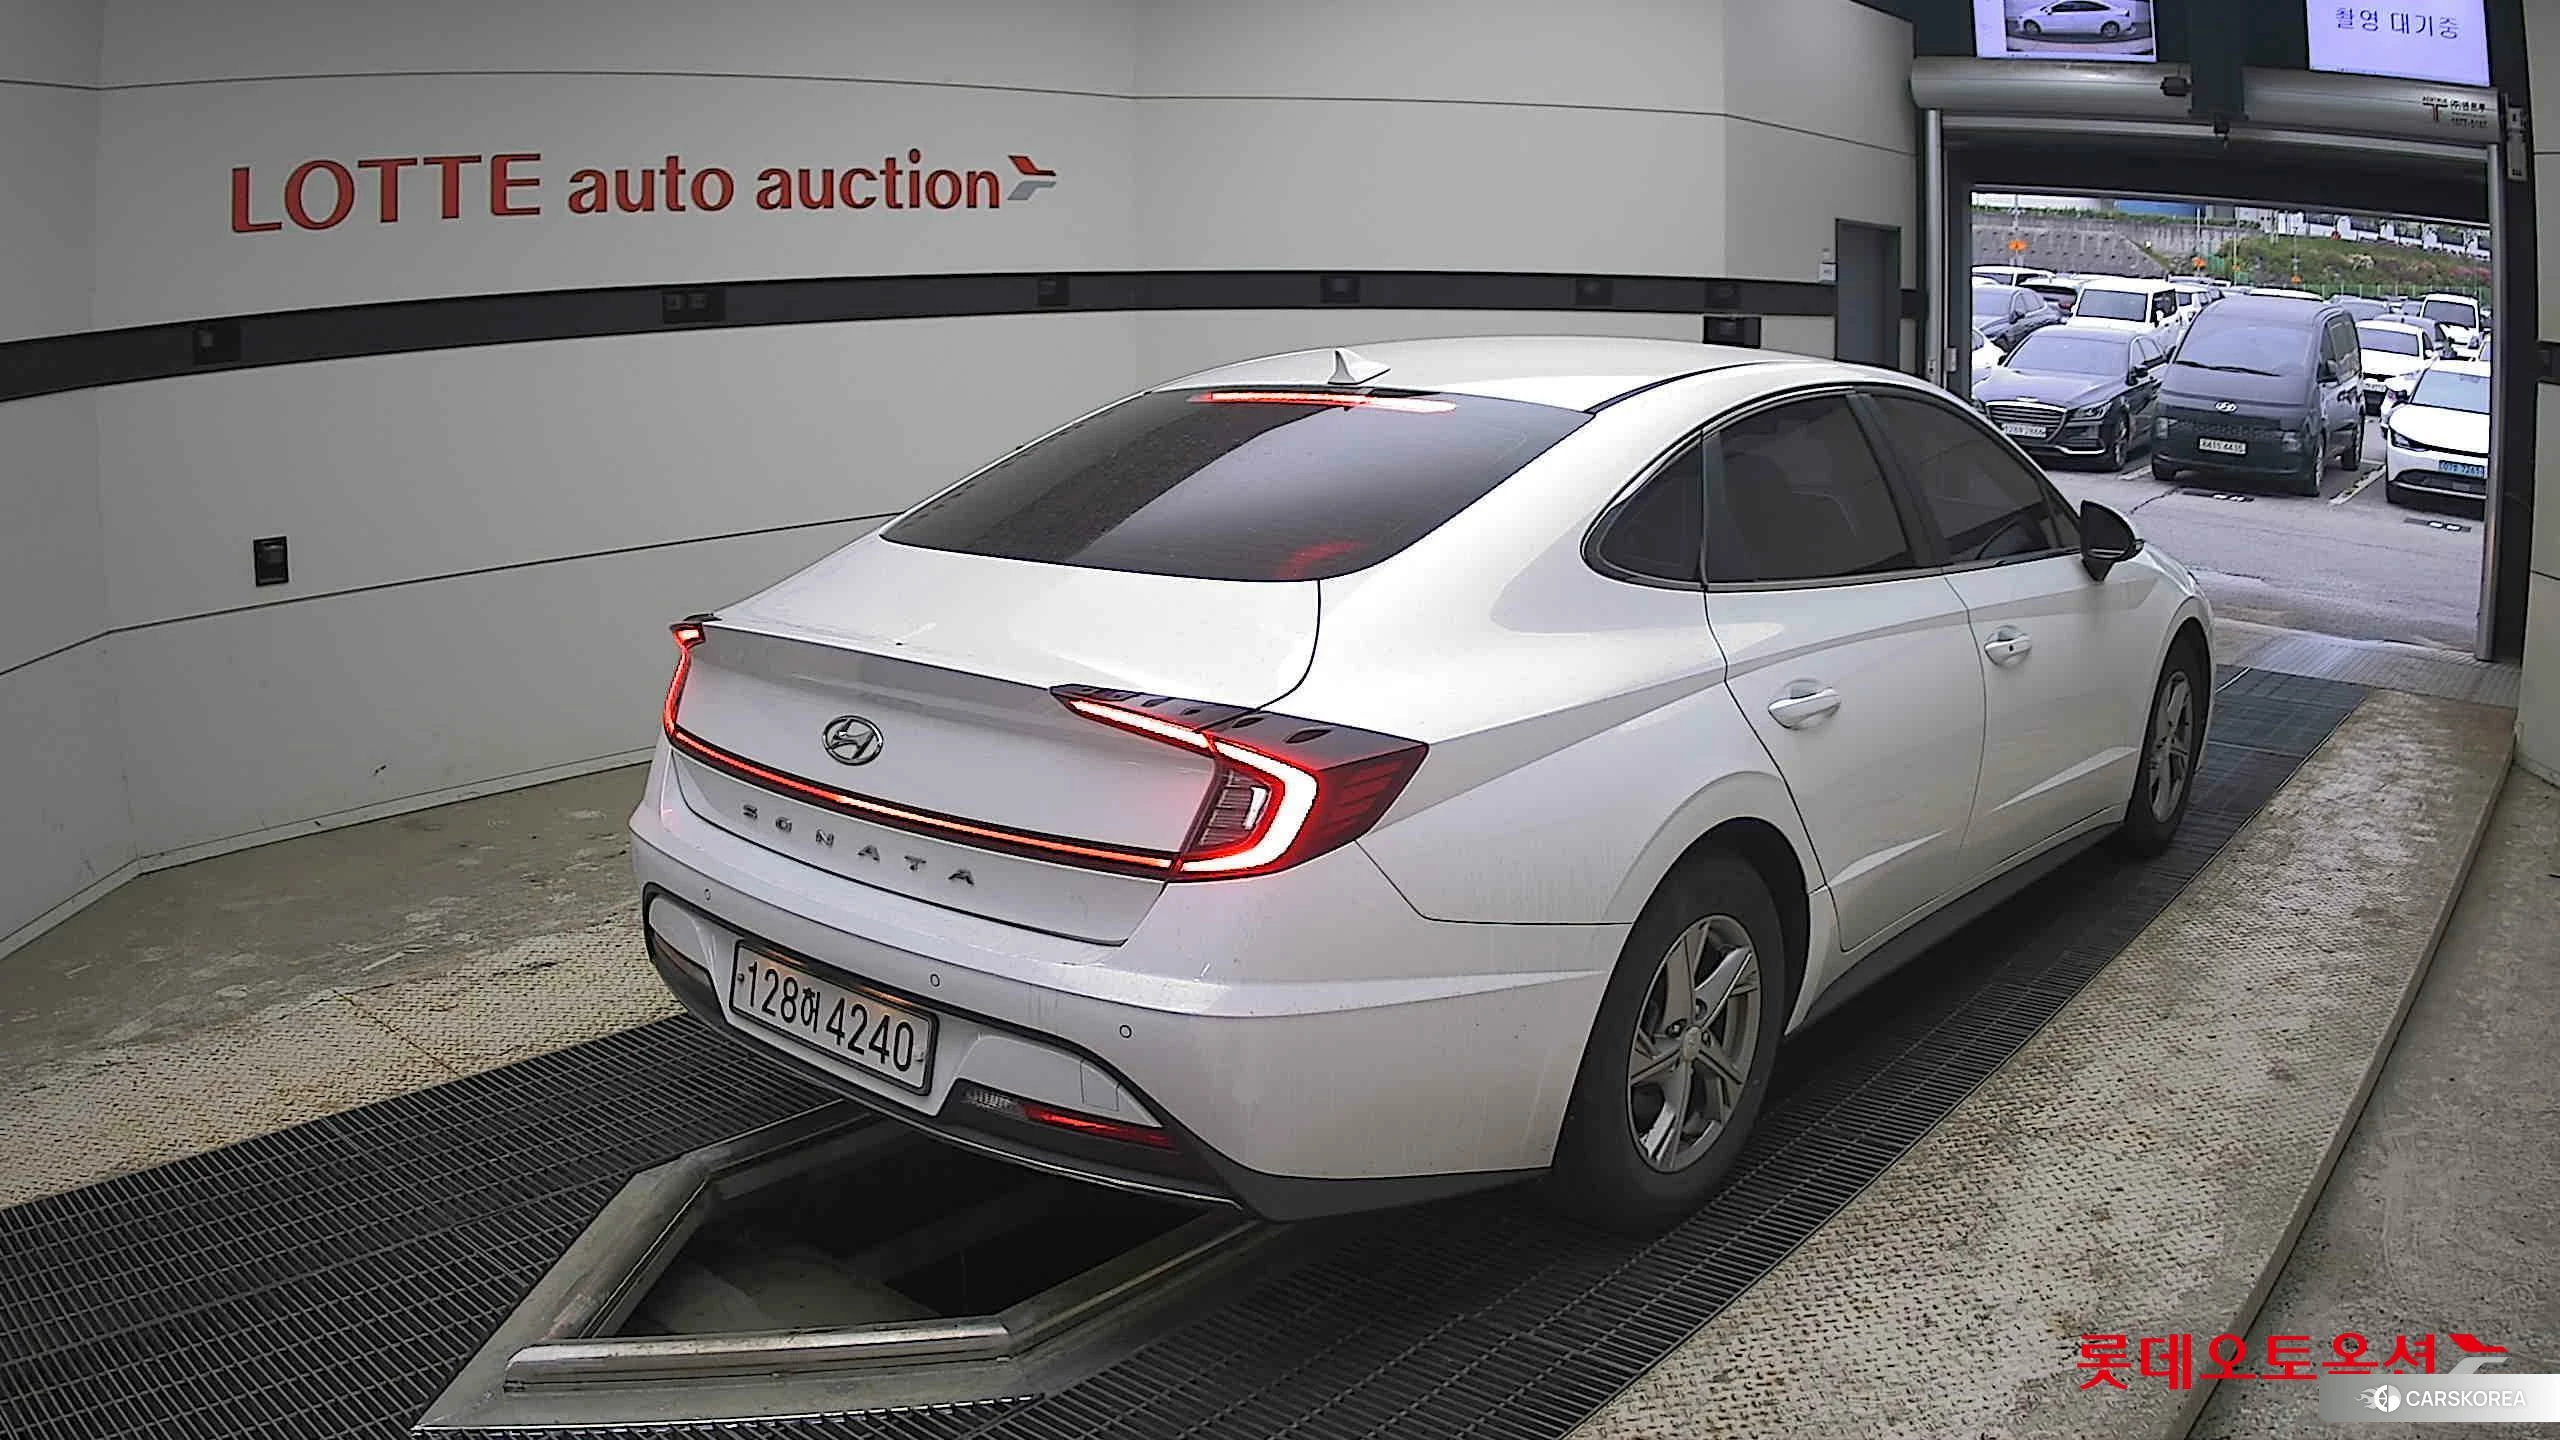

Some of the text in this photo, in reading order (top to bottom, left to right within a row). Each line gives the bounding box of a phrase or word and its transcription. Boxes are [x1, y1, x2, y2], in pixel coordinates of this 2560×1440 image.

[2390, 12, 2458, 39] 대기중
[231, 148, 1001, 233] LOTTE auto auction
[743, 804, 975, 886] SONATA
